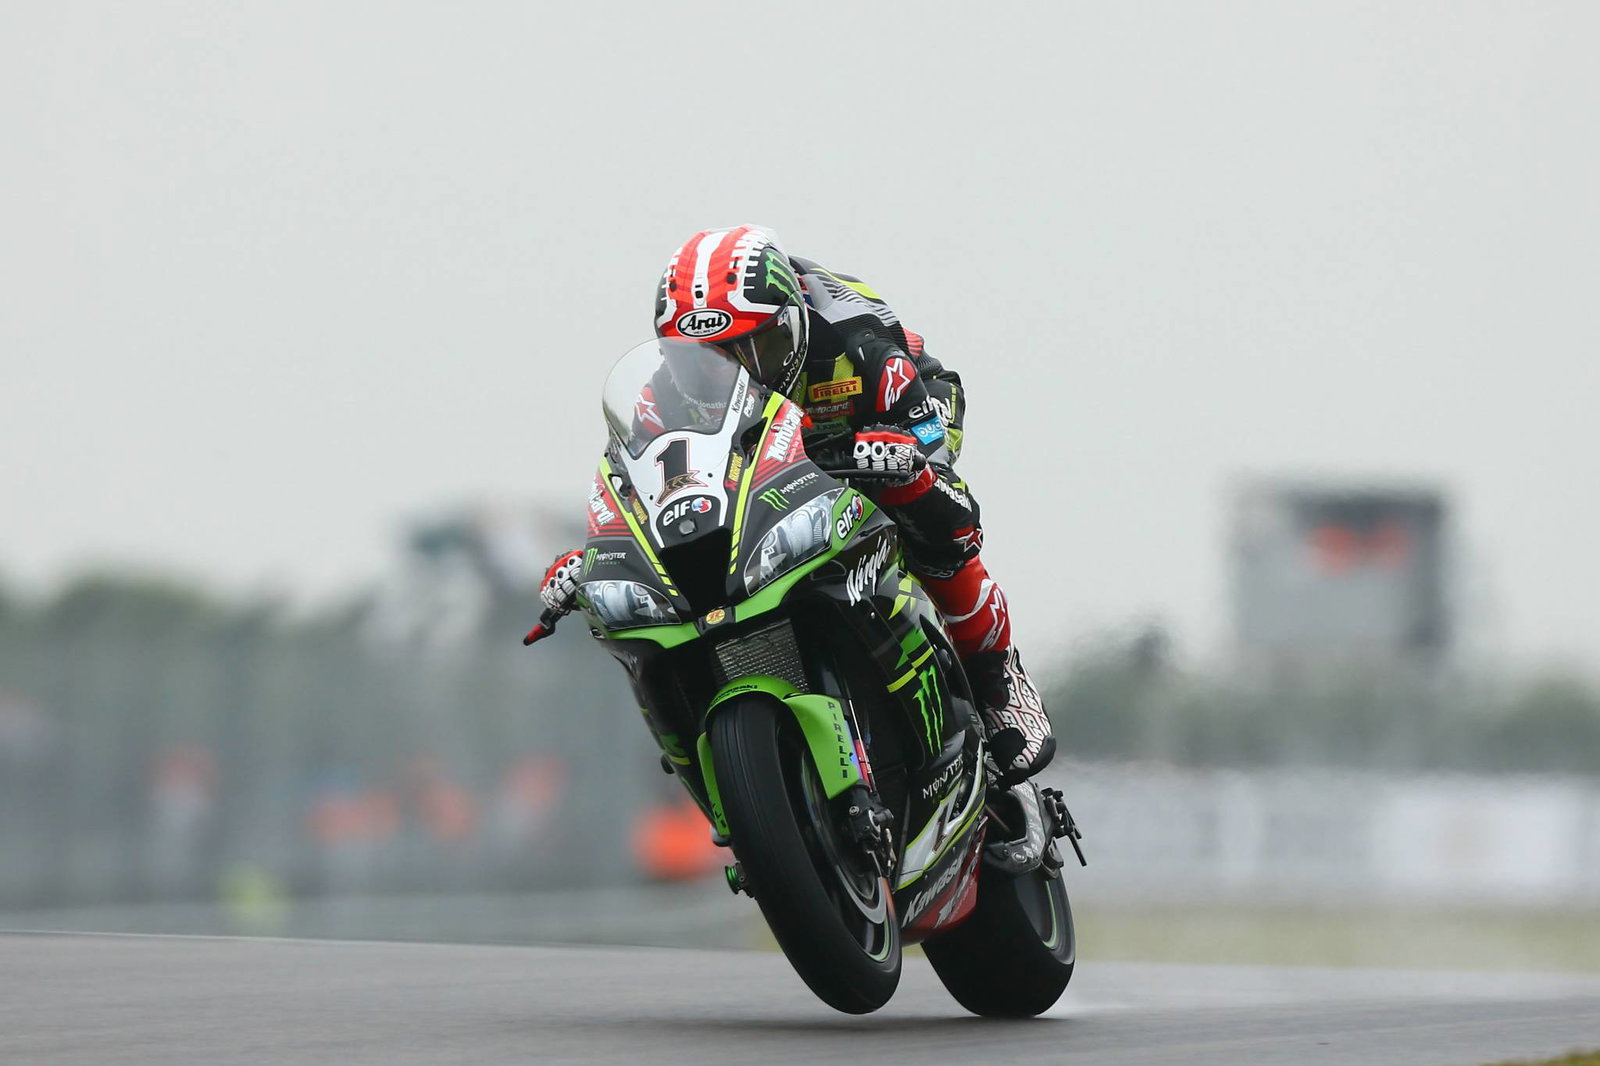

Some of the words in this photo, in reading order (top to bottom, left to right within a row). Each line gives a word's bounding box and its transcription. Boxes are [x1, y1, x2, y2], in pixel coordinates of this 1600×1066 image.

[680, 312, 724, 332] Arai
[731, 381, 746, 413] Kawasaki
[813, 380, 857, 399] PIRELLI
[655, 438, 700, 506] 1
[780, 472, 819, 495] MONSTER
[934, 478, 972, 512] awasaki
[663, 500, 691, 526] elf
[836, 505, 854, 539] elf
[596, 552, 626, 560] MONSTER
[846, 535, 891, 607] Ninja
[827, 701, 848, 778] PIRELLI
